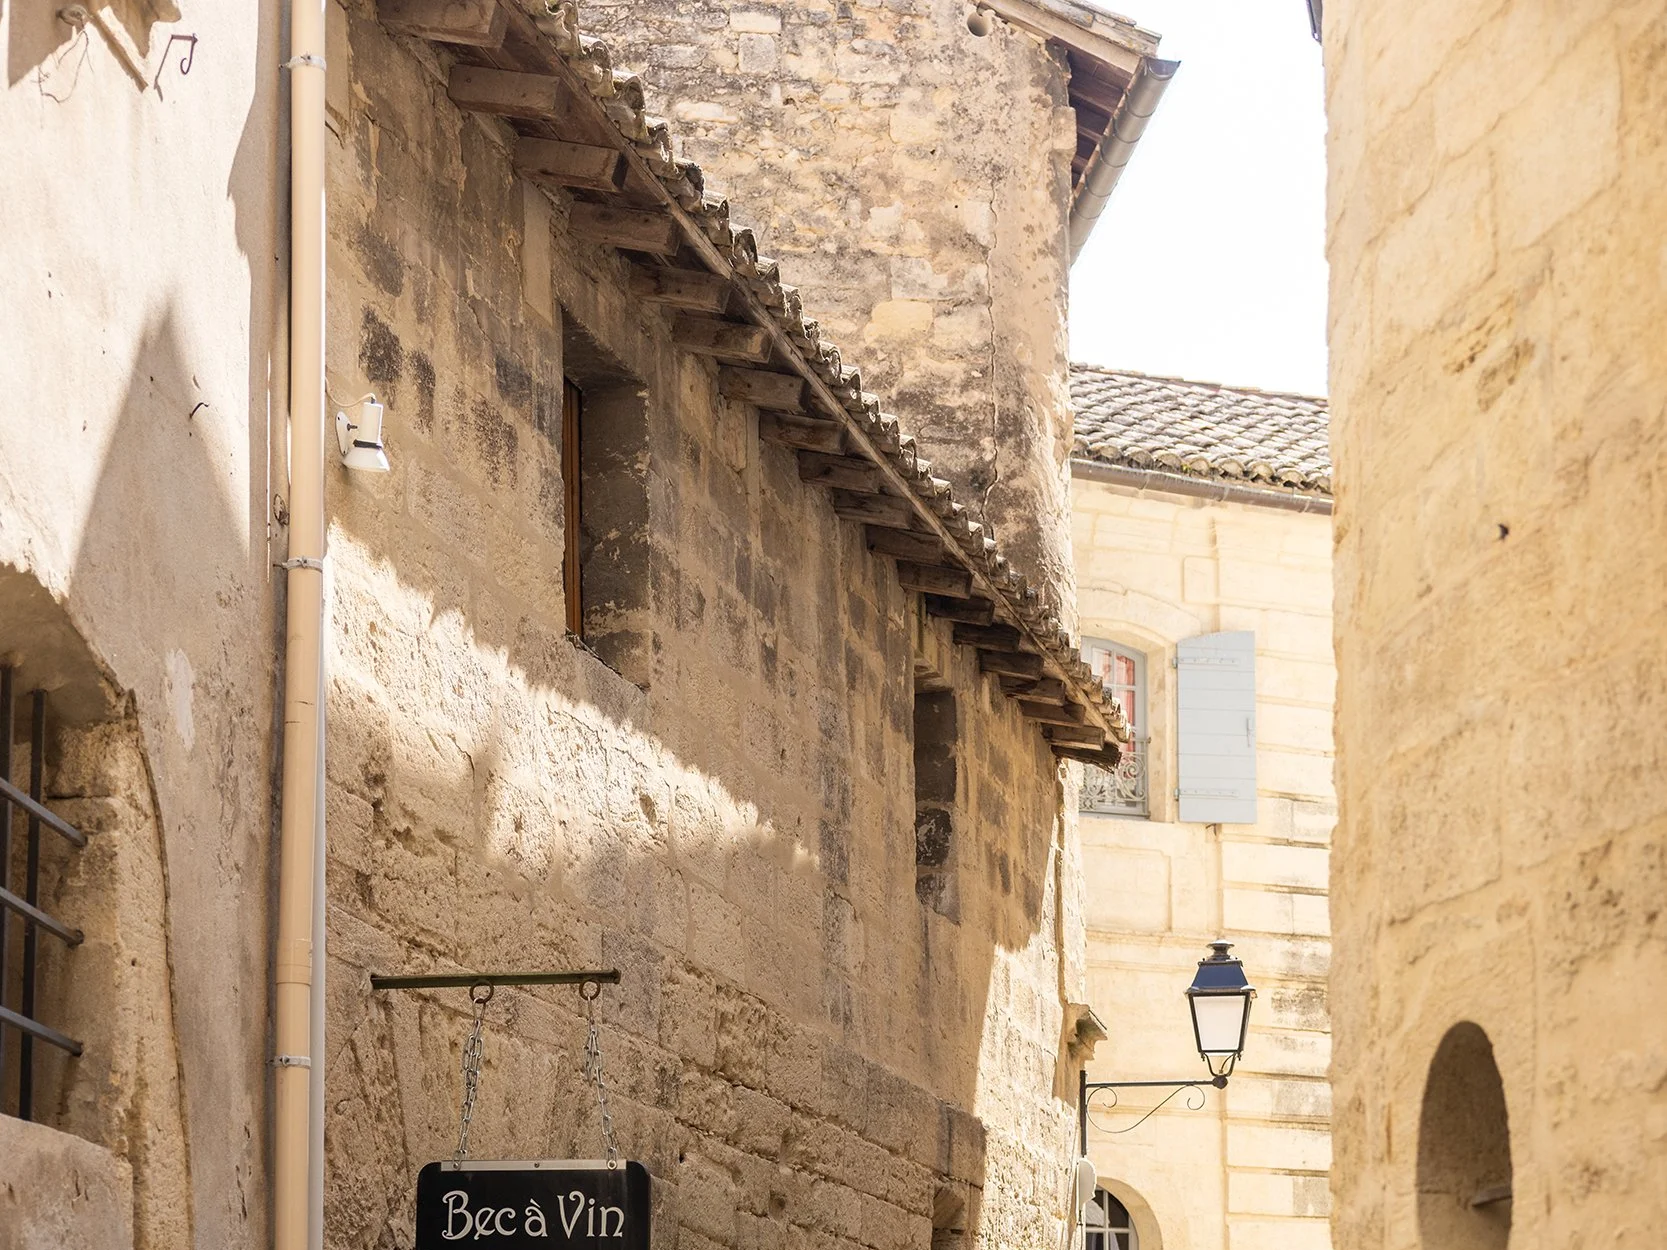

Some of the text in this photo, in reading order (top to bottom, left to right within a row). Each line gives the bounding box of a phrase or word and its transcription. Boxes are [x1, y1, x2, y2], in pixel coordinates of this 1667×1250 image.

[441, 1190, 625, 1241] Bec à Vin
